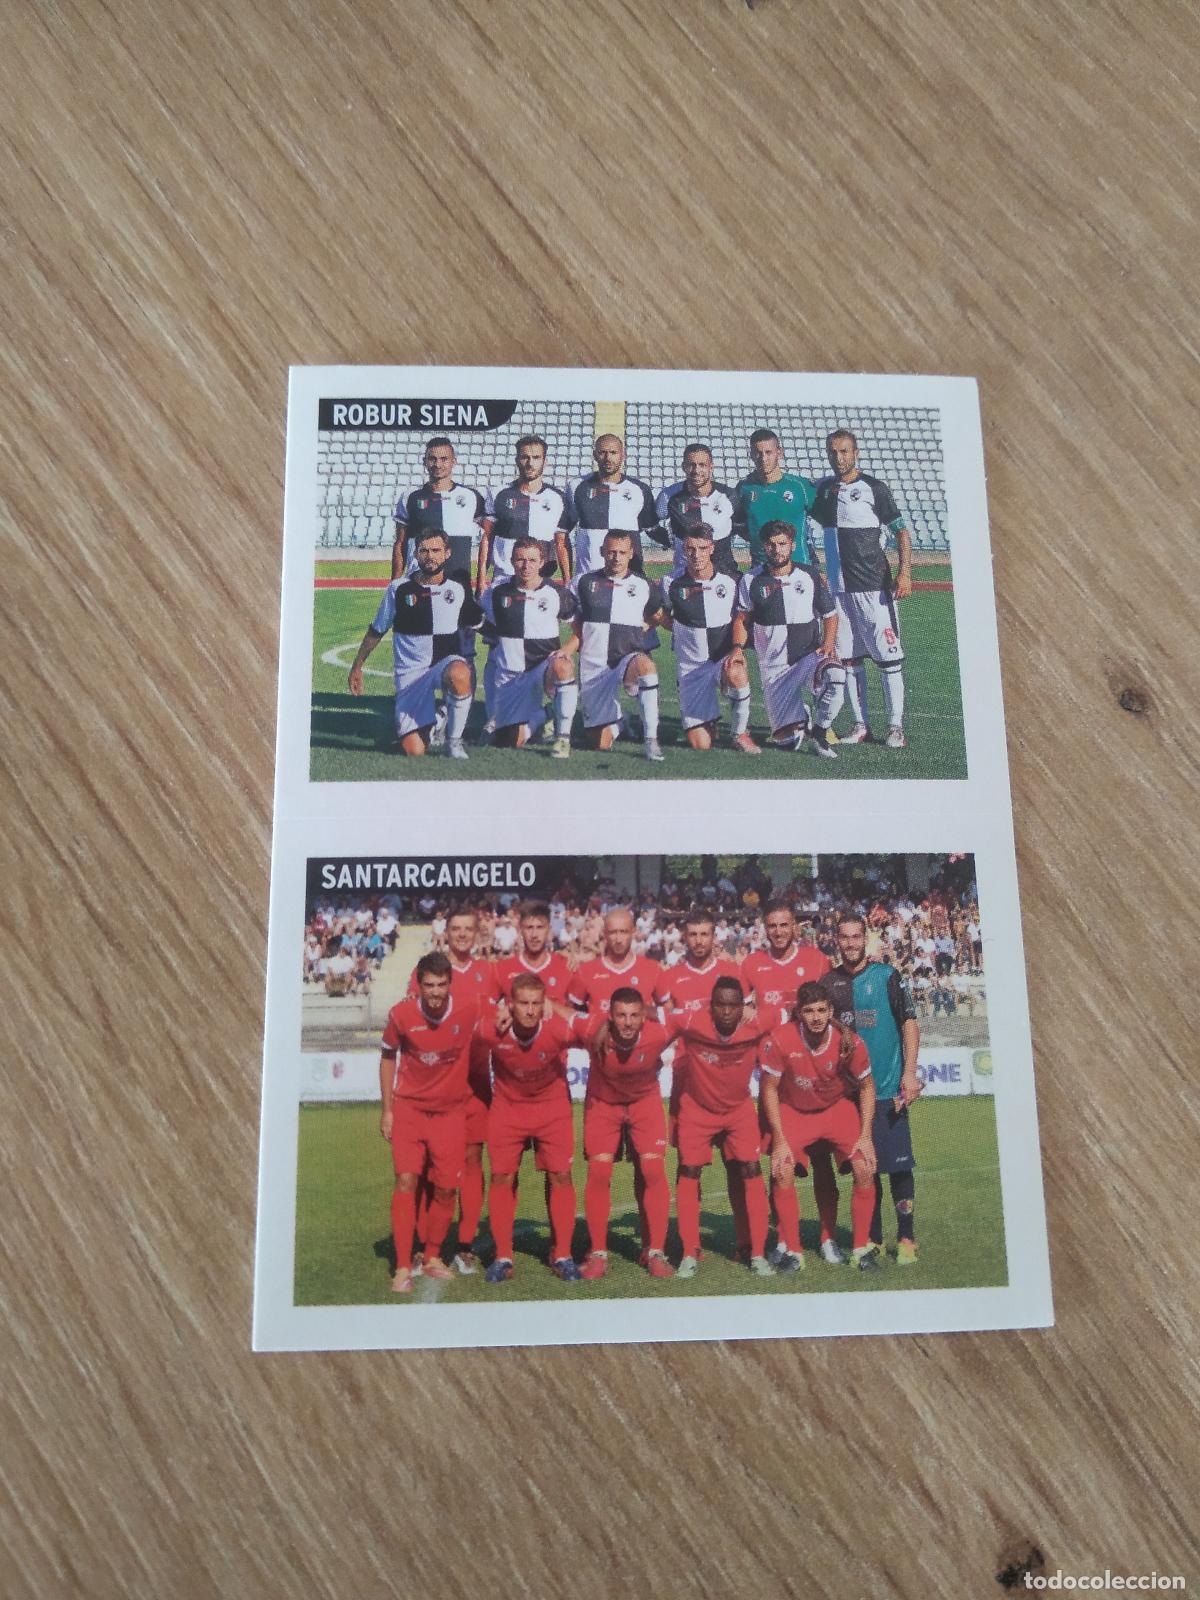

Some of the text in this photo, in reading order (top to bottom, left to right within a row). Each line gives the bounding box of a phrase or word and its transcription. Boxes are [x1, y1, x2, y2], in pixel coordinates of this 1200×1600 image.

[332, 404, 489, 426] ROBUR SIENA
[321, 862, 536, 889] SANTARCANGELO
